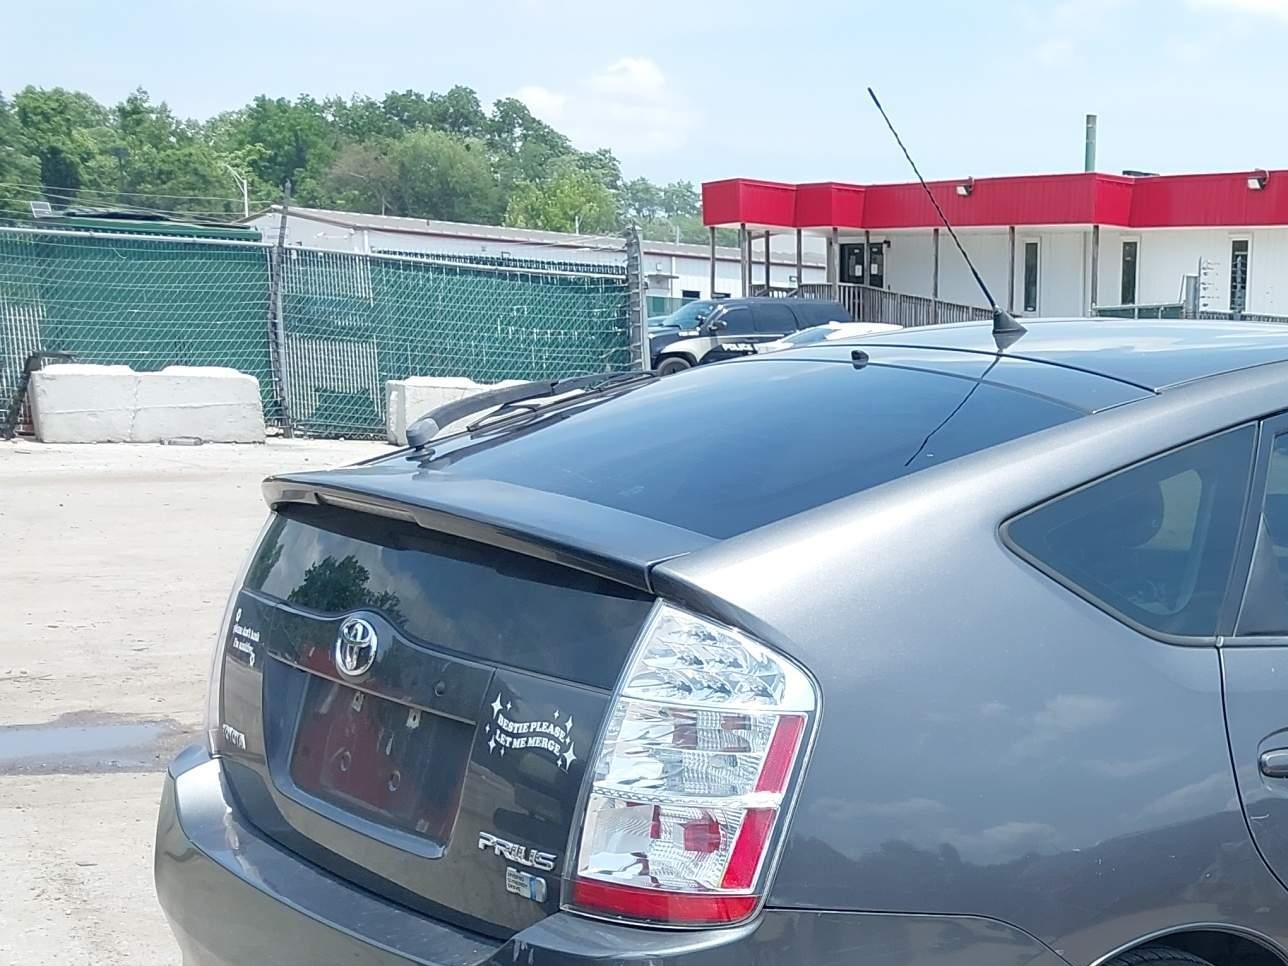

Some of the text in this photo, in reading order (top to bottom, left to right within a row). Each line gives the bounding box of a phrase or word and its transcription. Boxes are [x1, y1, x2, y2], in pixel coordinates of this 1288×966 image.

[496, 729, 561, 756] LET ME MERGE
[498, 714, 566, 743] BESTIE PLEASE
[479, 832, 557, 871] PRIUS
